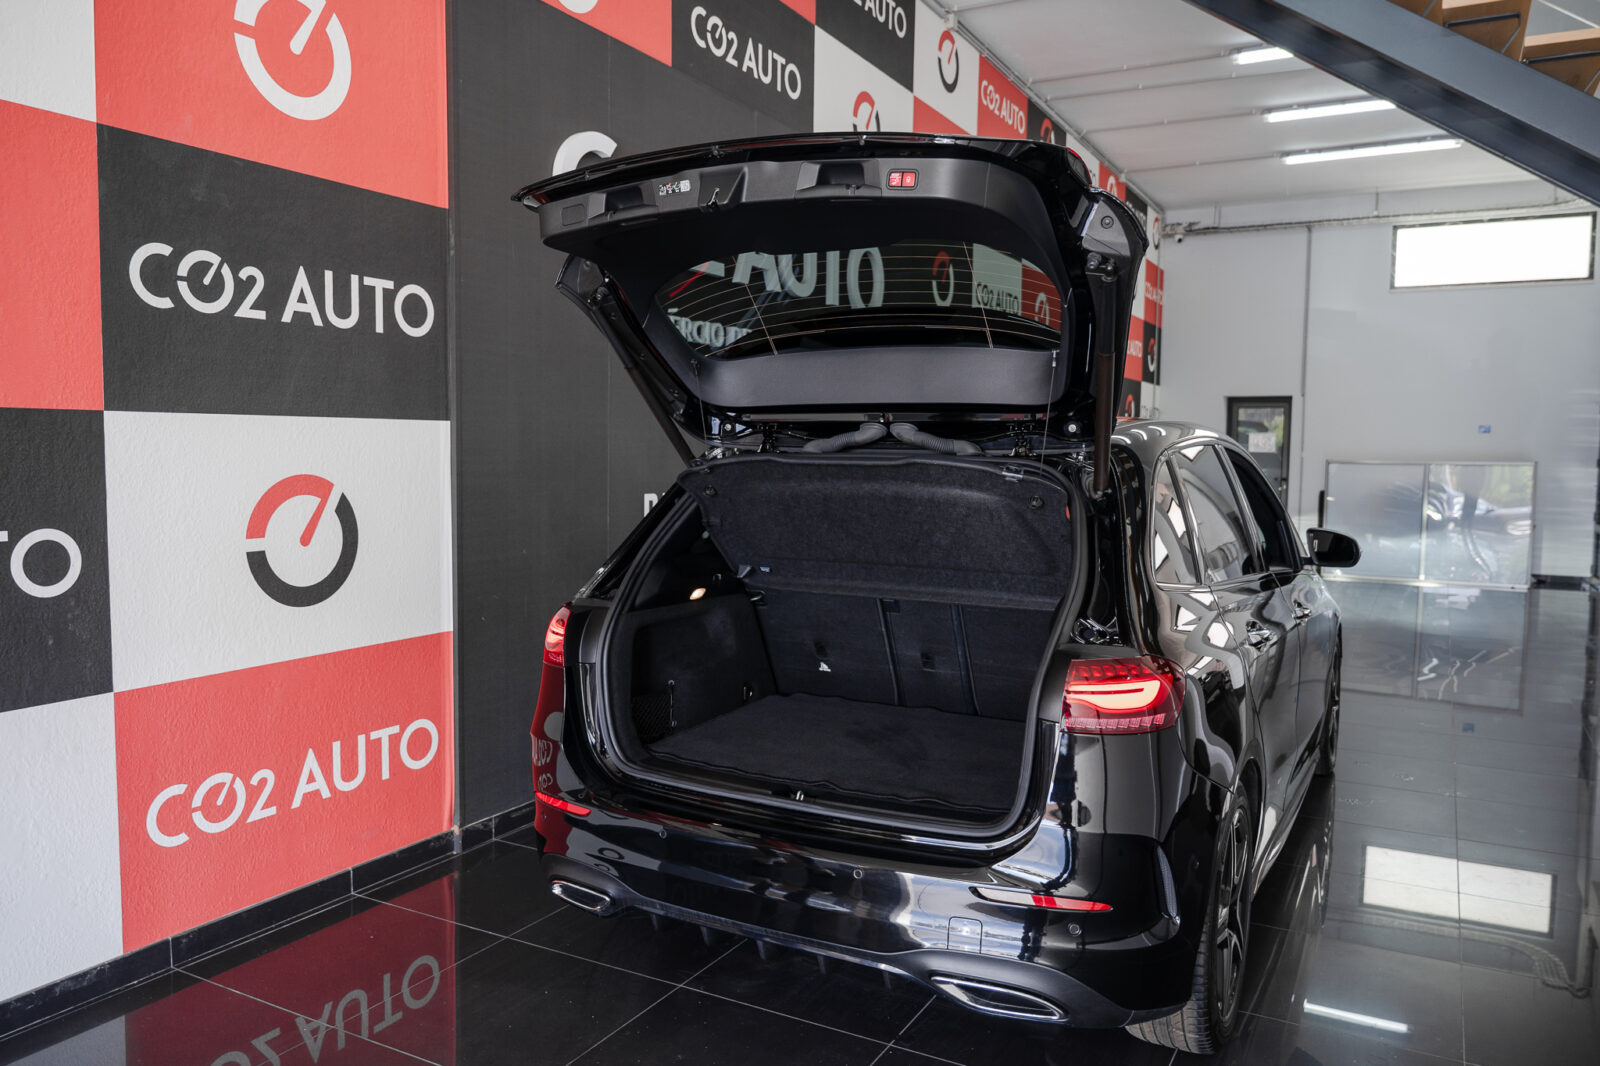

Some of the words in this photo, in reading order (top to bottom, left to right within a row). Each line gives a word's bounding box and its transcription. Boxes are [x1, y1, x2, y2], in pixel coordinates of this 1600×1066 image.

[690, 6, 738, 67] CO2
[742, 37, 801, 100] AUTO
[981, 80, 999, 116] CO2
[1000, 97, 1025, 134] AUTO
[129, 242, 267, 320] CO2
[281, 266, 435, 338] AUTO
[146, 770, 276, 848] CO2
[291, 718, 439, 809] AUTO
